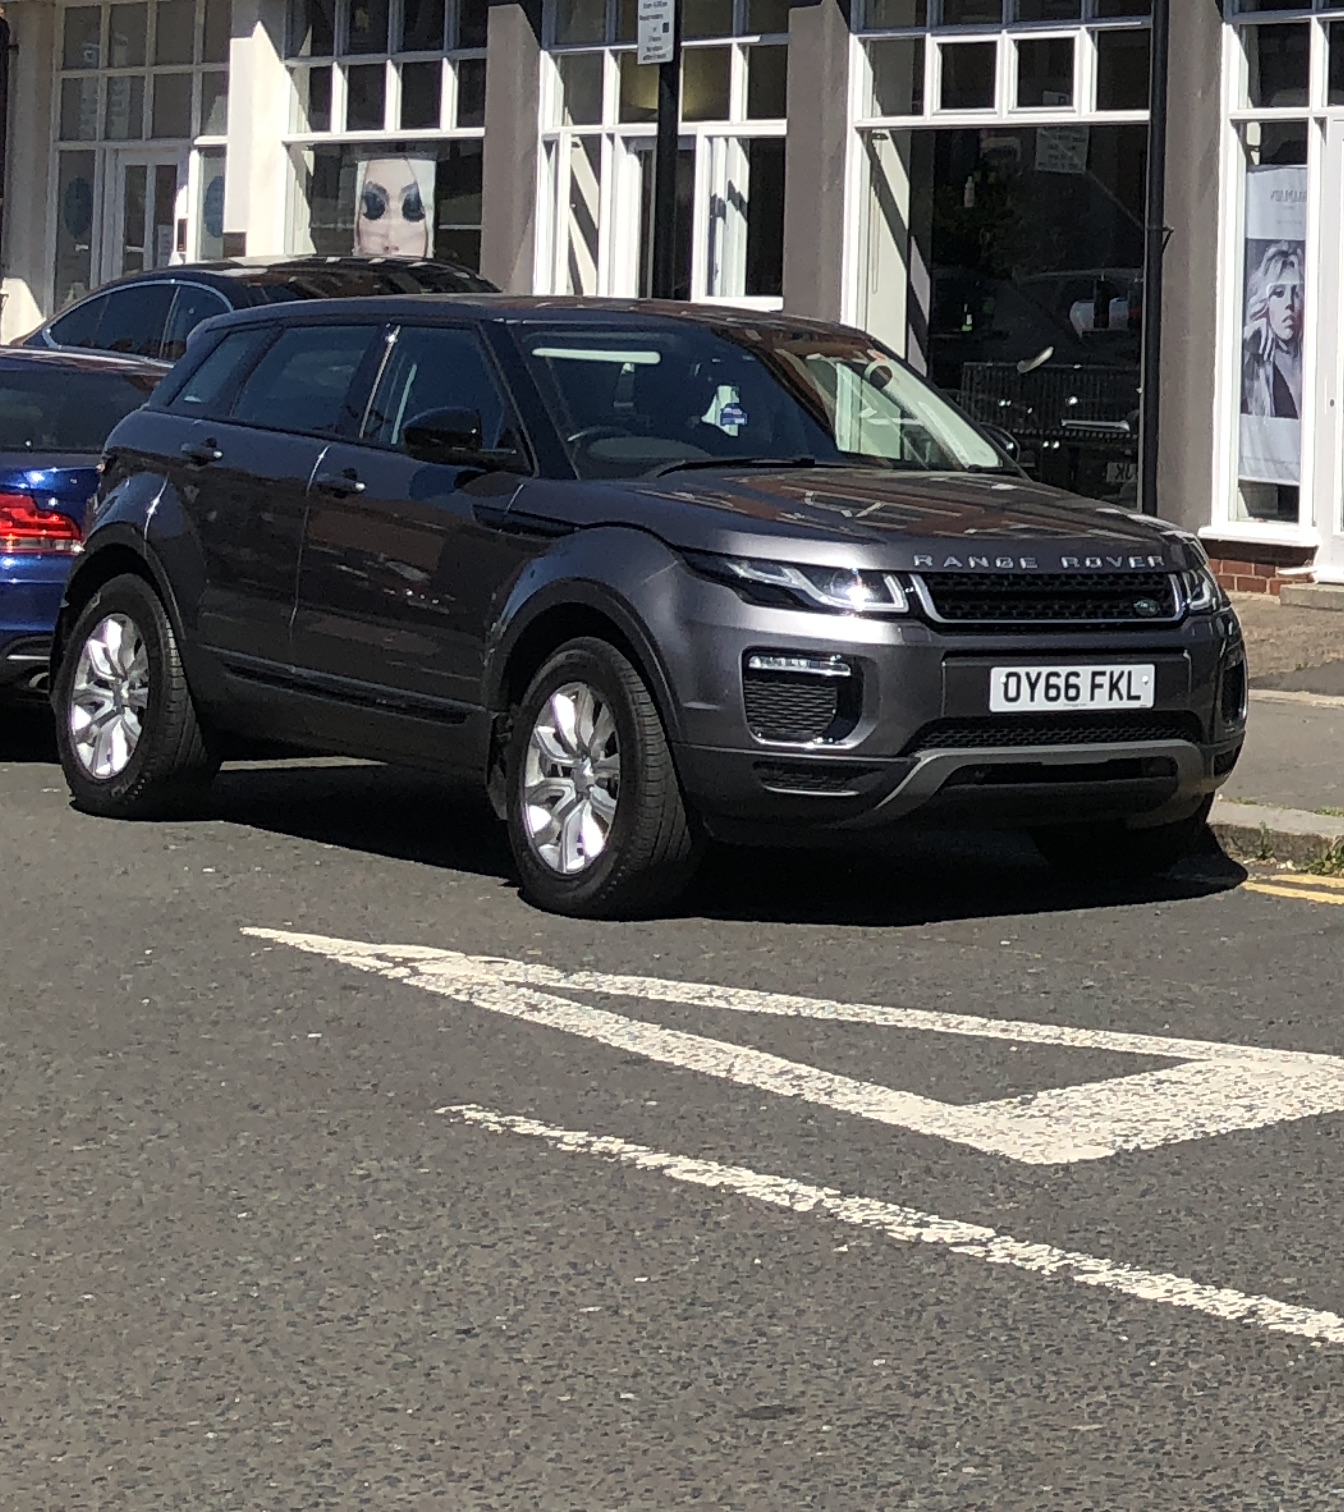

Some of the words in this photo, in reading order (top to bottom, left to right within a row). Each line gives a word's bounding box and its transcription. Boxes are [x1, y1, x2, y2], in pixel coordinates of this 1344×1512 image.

[913, 554, 1038, 569] RANGE
[1061, 555, 1166, 569] ROVER
[1003, 671, 1081, 703] OY66
[1089, 670, 1142, 702] FKL
